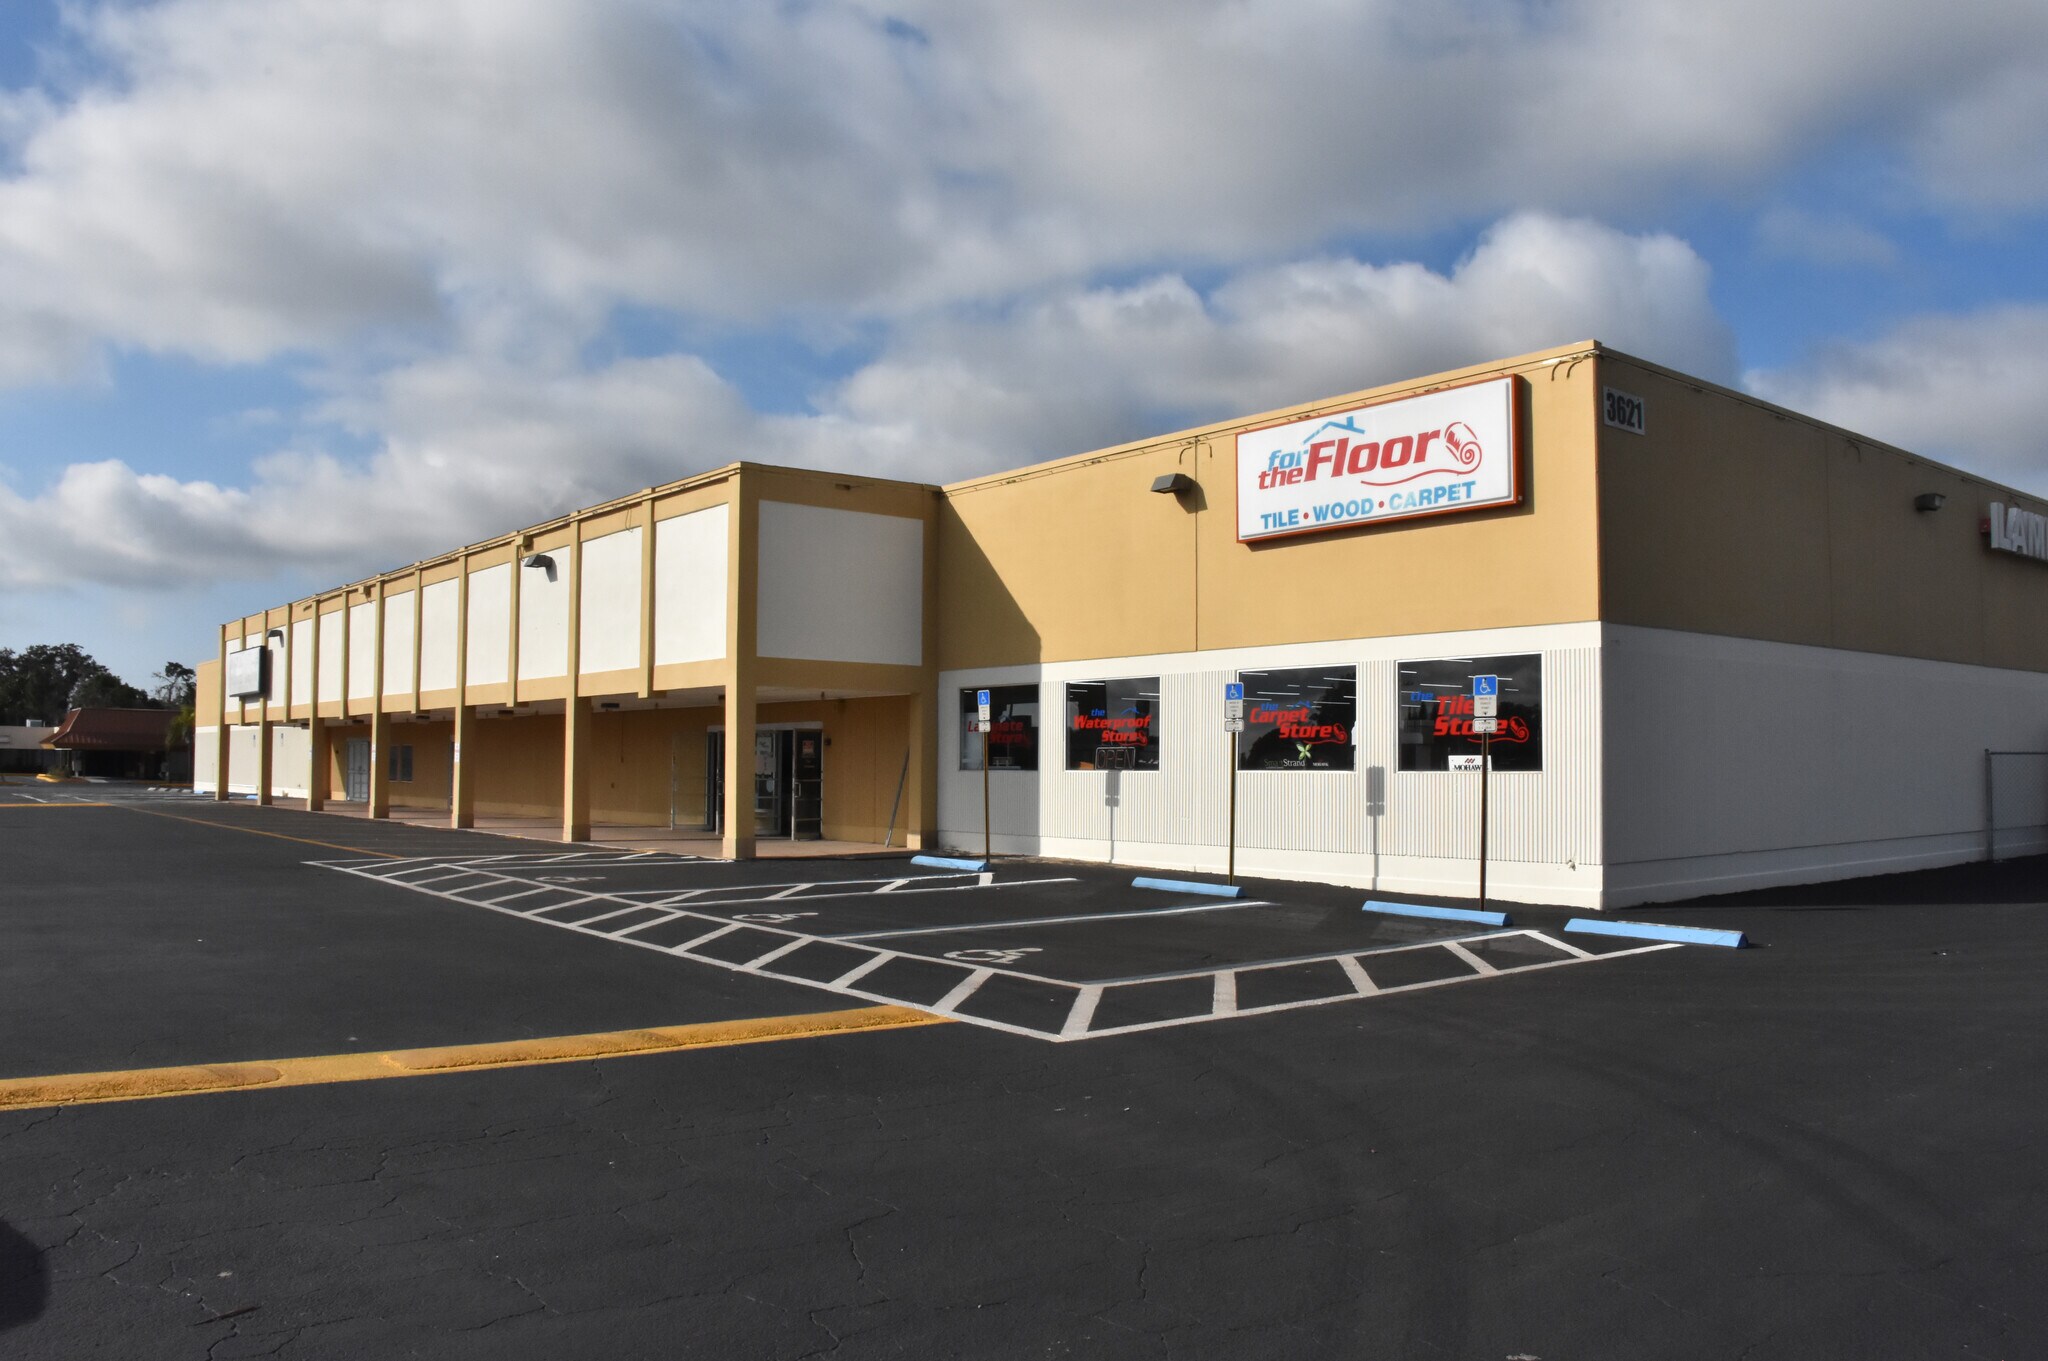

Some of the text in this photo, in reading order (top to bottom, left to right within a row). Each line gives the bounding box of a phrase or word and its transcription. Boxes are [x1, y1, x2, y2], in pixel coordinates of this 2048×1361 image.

[1606, 392, 1643, 430] 3621
[1258, 429, 1441, 490] the Floor
[1267, 449, 1309, 472] for
[1260, 480, 1477, 530] TILE WOOD CARPET
[1411, 688, 1434, 702] the
[1436, 695, 1475, 715] Tile
[1091, 708, 1106, 717] the
[1250, 707, 1310, 727] Carpet
[1261, 703, 1279, 712] the
[1073, 714, 1152, 731] Waterproof
[1279, 722, 1333, 738] Store
[1433, 716, 1508, 736] Stoe
[1102, 730, 1138, 742] Store
[1097, 749, 1135, 769] OPEN
